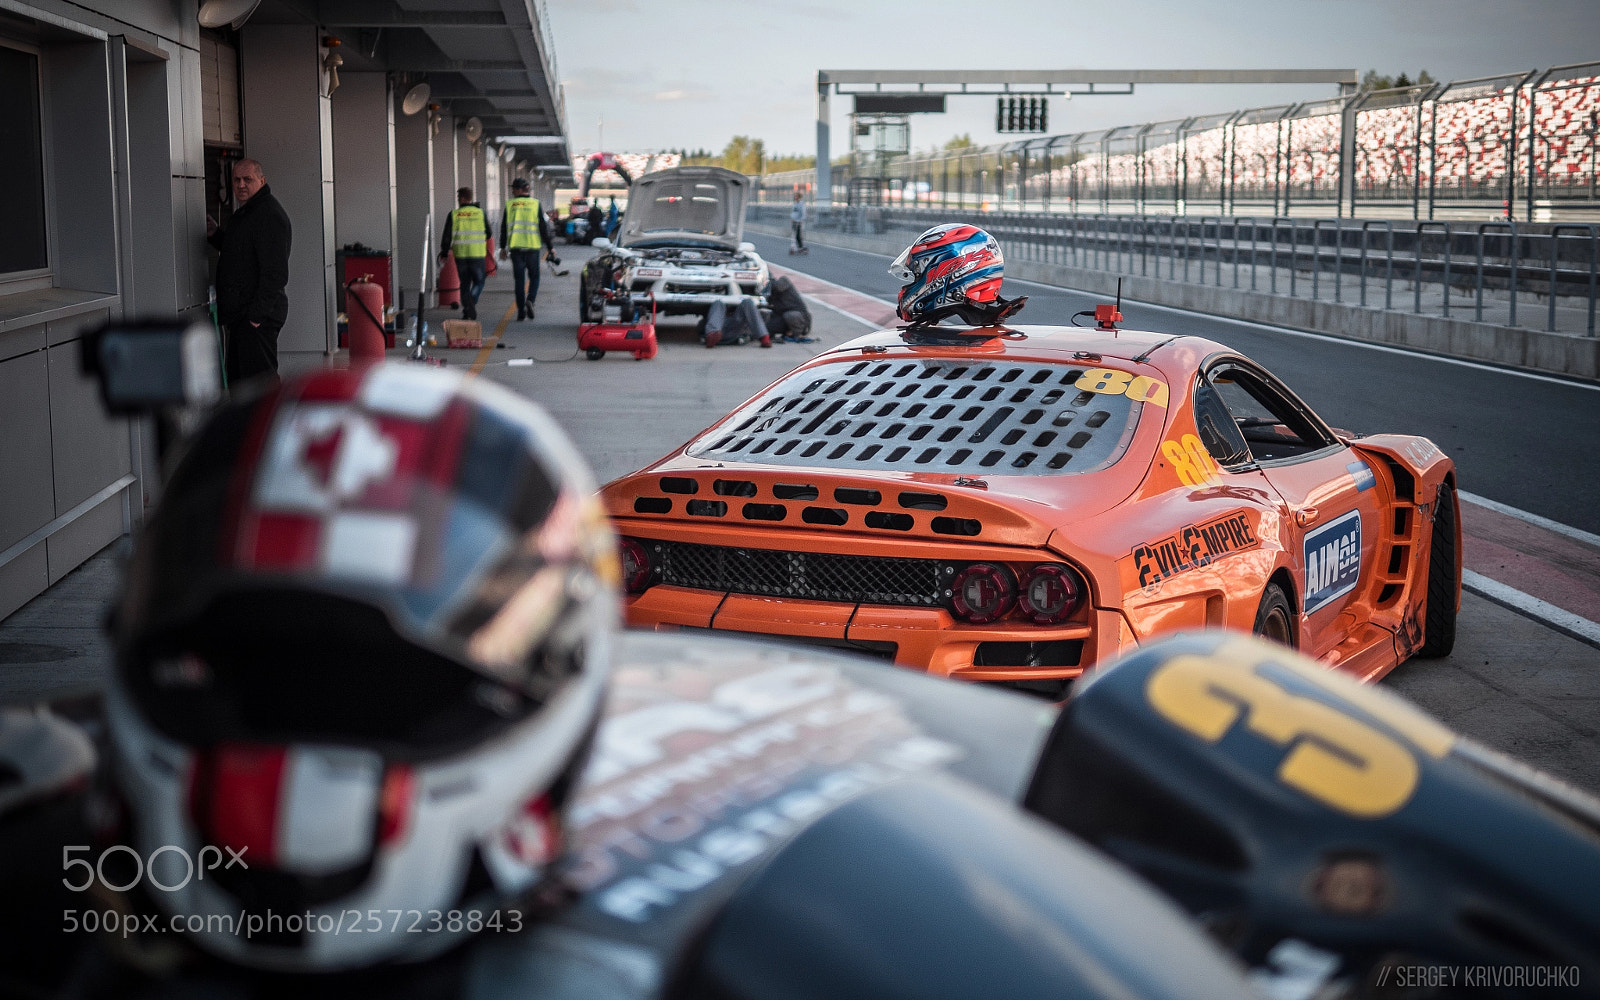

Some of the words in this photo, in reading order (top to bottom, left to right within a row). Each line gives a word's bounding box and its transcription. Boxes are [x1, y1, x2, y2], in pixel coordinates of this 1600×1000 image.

[1074, 368, 1169, 409] 80
[1160, 433, 1224, 492] 80
[1183, 515, 1255, 568] EMPIRE
[1306, 530, 1359, 600] AIMOL
